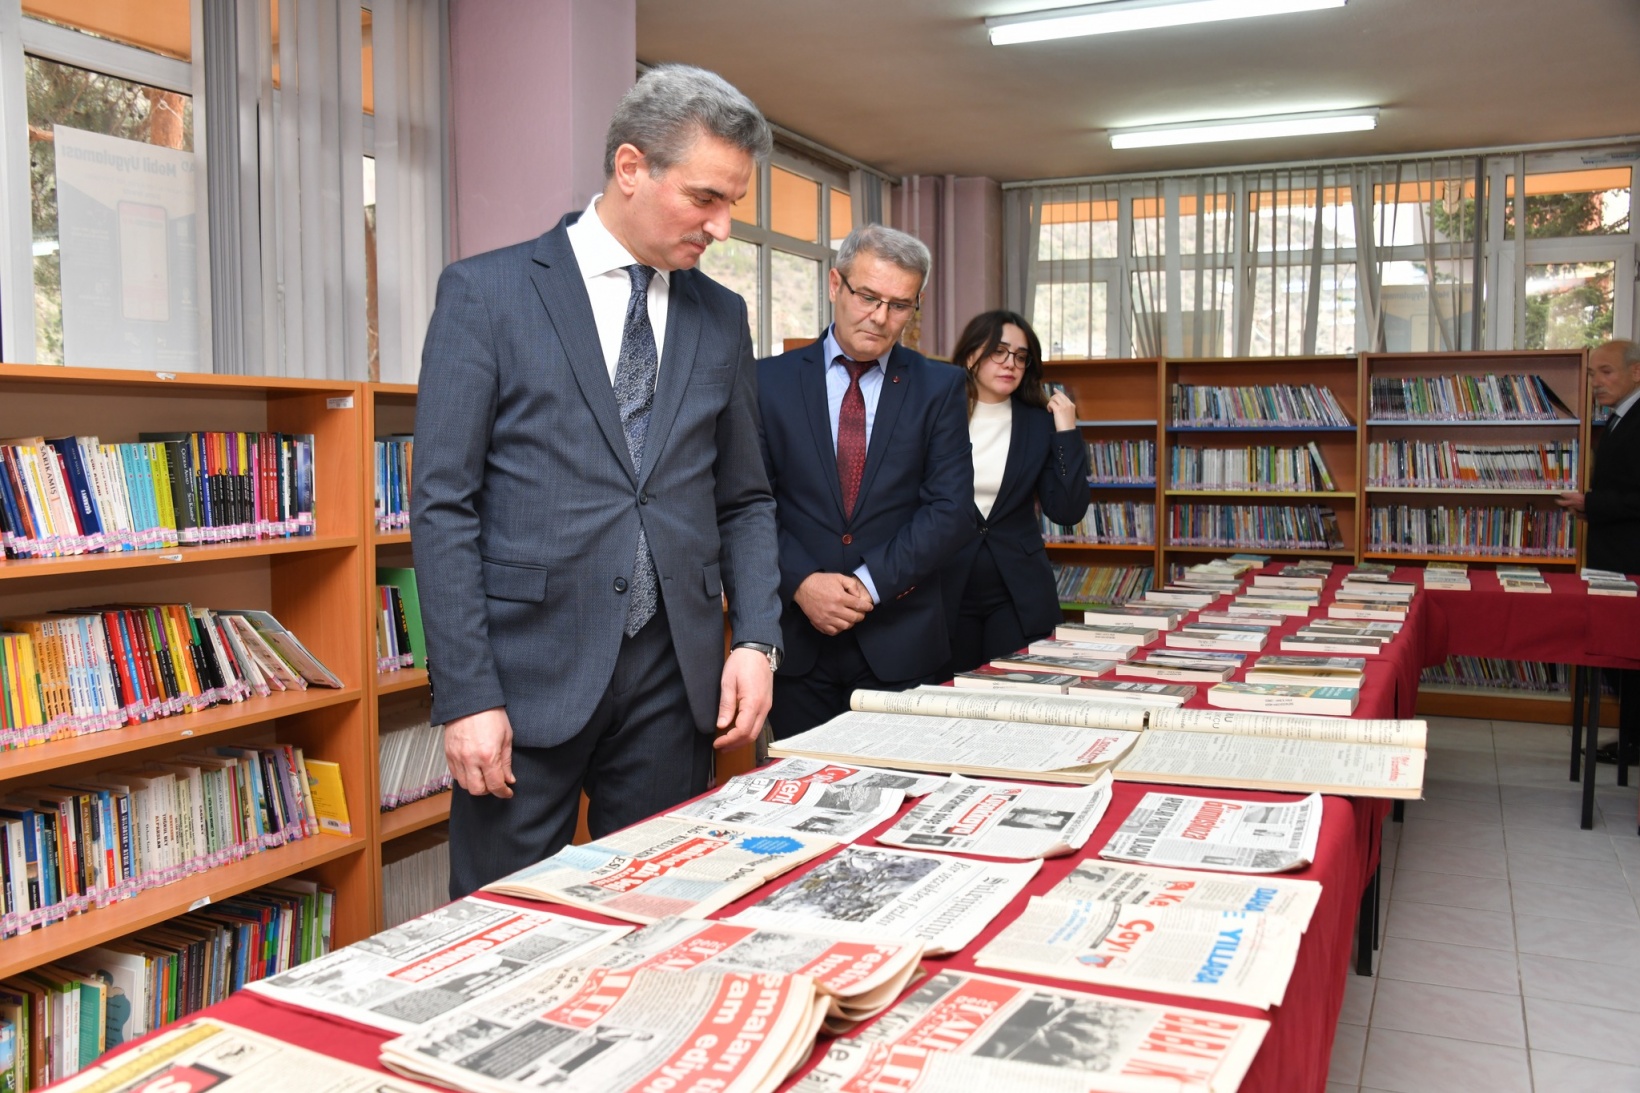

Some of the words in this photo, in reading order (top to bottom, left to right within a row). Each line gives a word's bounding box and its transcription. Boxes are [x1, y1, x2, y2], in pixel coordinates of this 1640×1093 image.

[40, 446, 57, 495] SARIKAMIŞ
[947, 793, 1012, 835] Kuşakkaya
[1179, 800, 1242, 840] Gümüşkoza
[914, 876, 1008, 941] Süleymaniye
[1242, 887, 1277, 911] DAHA
[1104, 919, 1156, 953] Çayı
[1191, 928, 1243, 984] YILLARA
[1138, 1013, 1239, 1061] BABA
